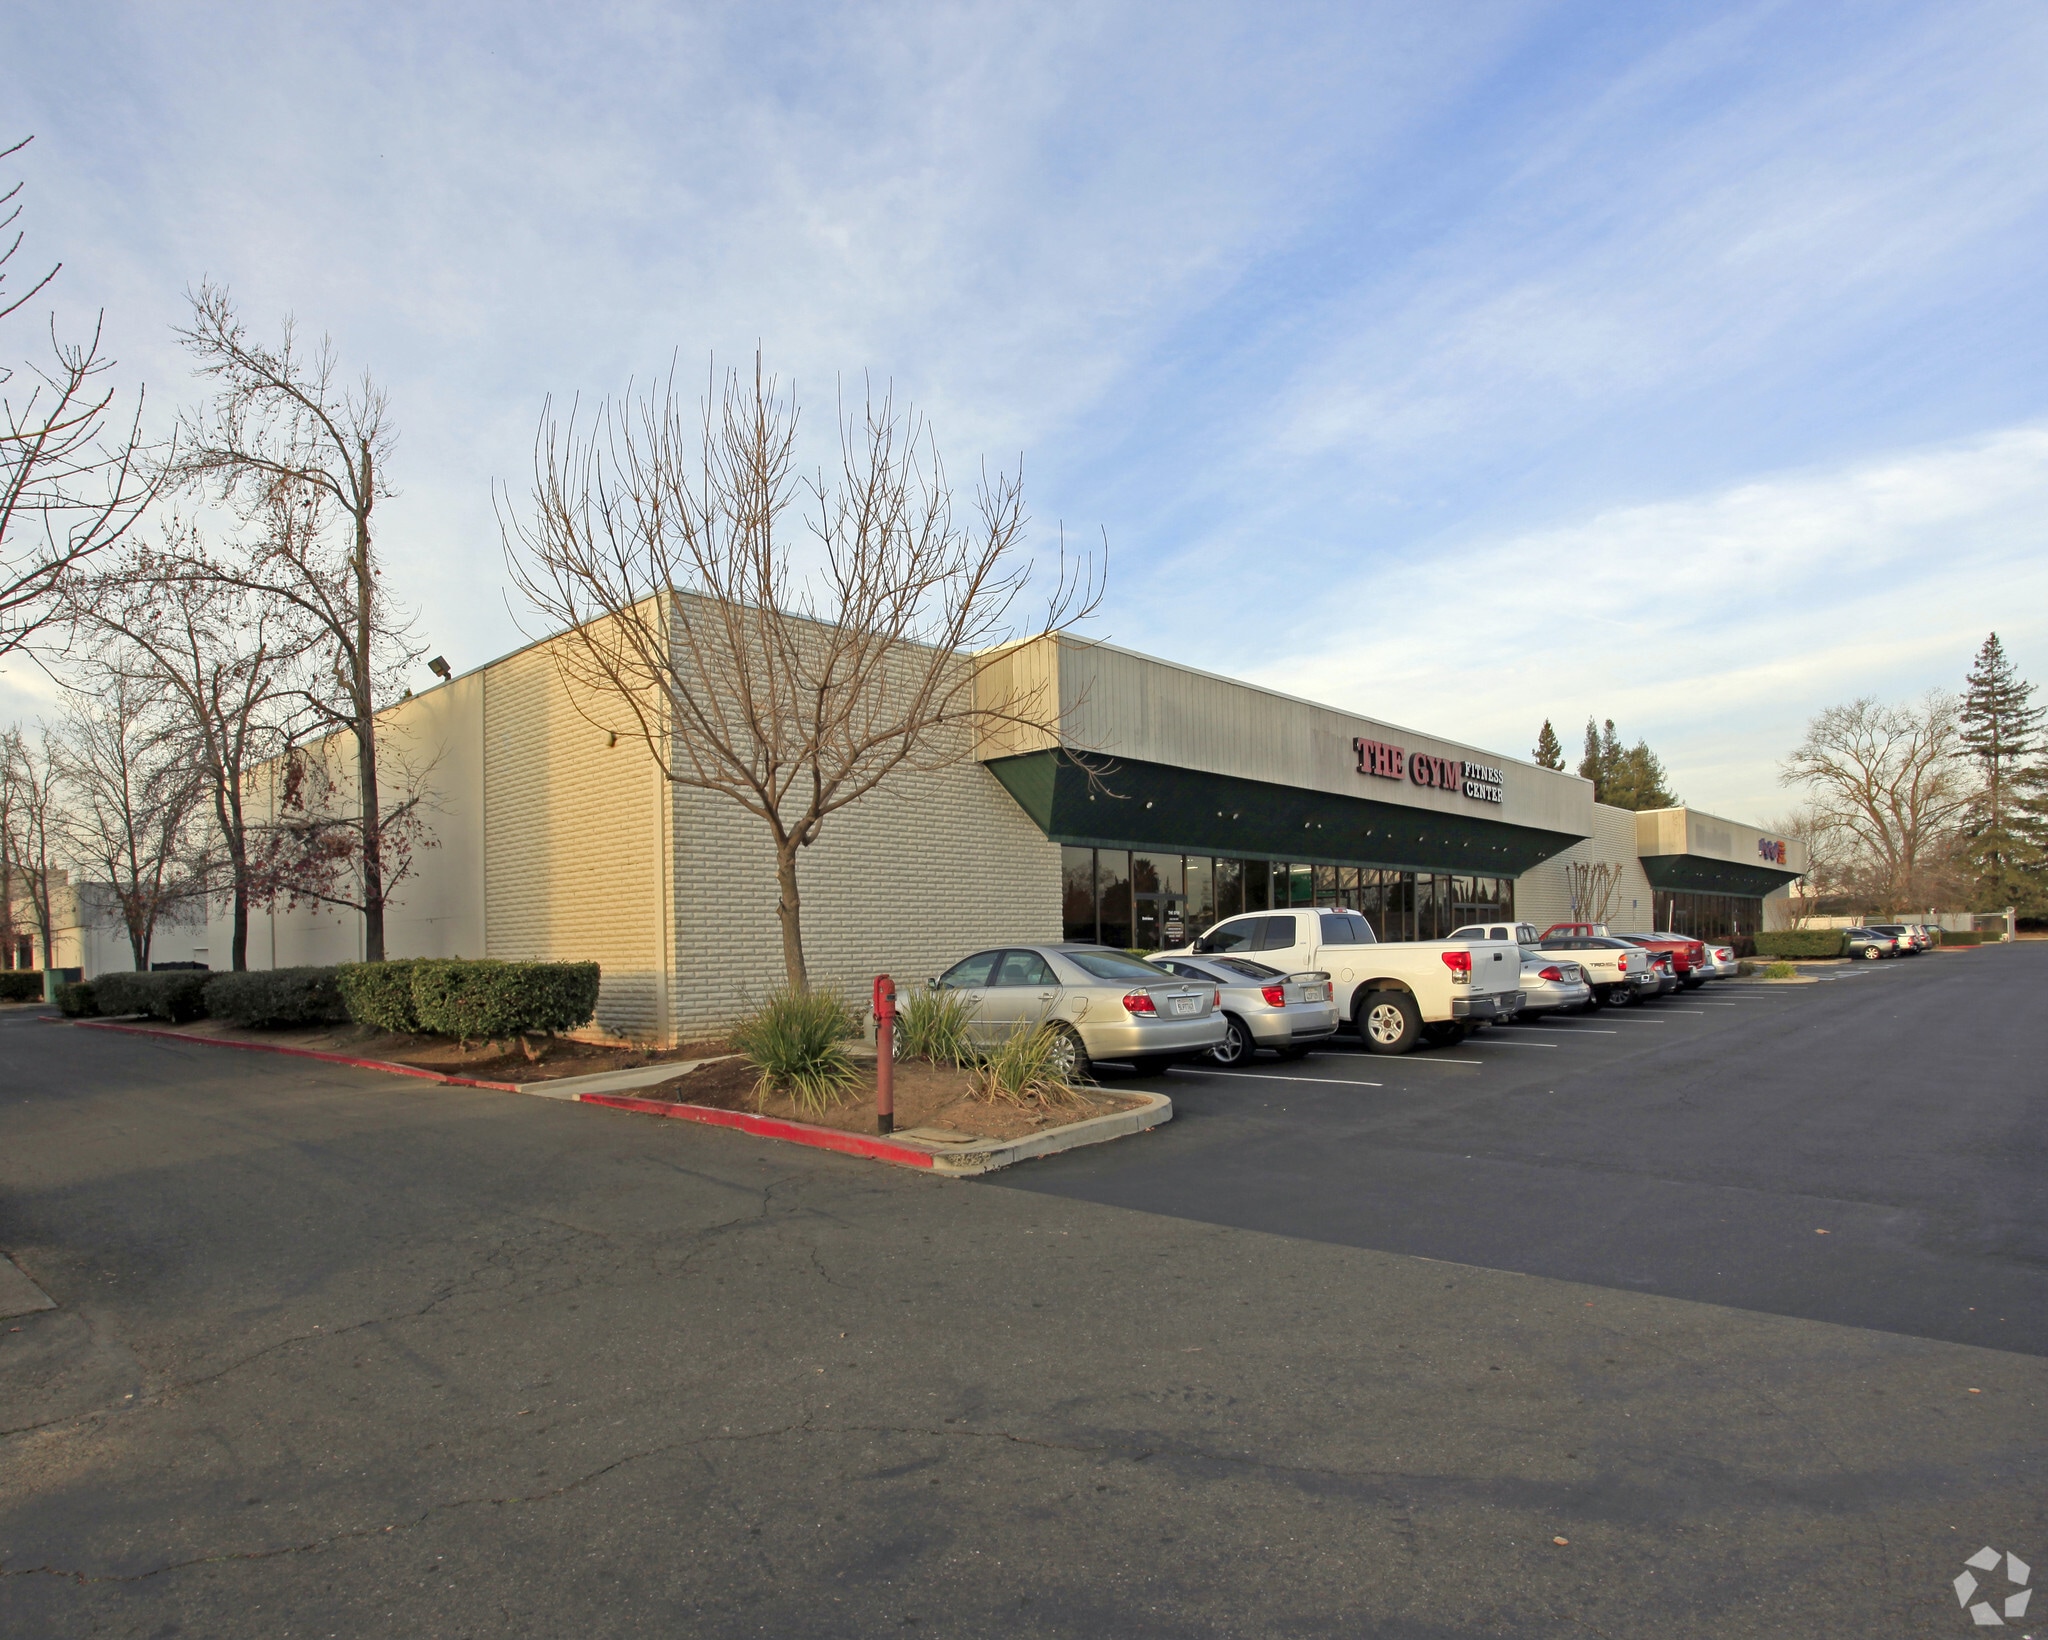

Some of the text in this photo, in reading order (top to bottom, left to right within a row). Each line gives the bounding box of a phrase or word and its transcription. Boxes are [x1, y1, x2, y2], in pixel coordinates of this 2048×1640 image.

[1353, 737, 1461, 791] THE GYM
[1463, 761, 1504, 784] FITNESS
[1464, 782, 1504, 803] CENTER
